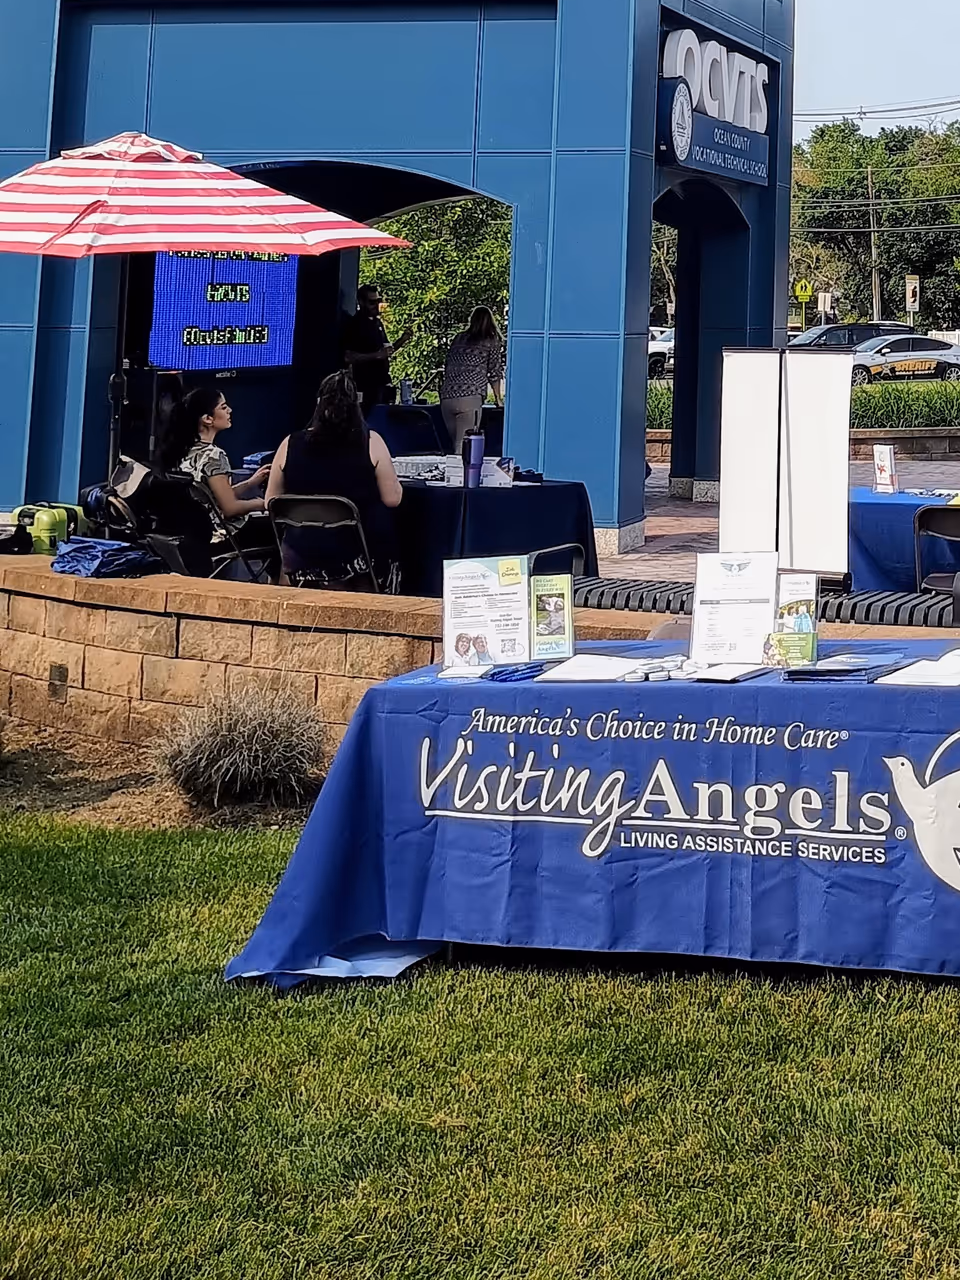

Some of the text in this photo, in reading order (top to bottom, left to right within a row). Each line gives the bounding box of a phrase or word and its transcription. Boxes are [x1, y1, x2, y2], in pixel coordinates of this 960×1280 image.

[663, 29, 769, 133] OCVTS
[713, 128, 751, 152] OCEAN COUNTY
[691, 144, 725, 168] VOCATIONAL
[895, 360, 937, 372] SHERIFF
[465, 707, 579, 740] America's
[586, 712, 667, 742] Choice
[672, 715, 697, 742] in
[702, 716, 776, 746] Home
[620, 833, 887, 865] LIVING ASSISTANCE SERVICES
